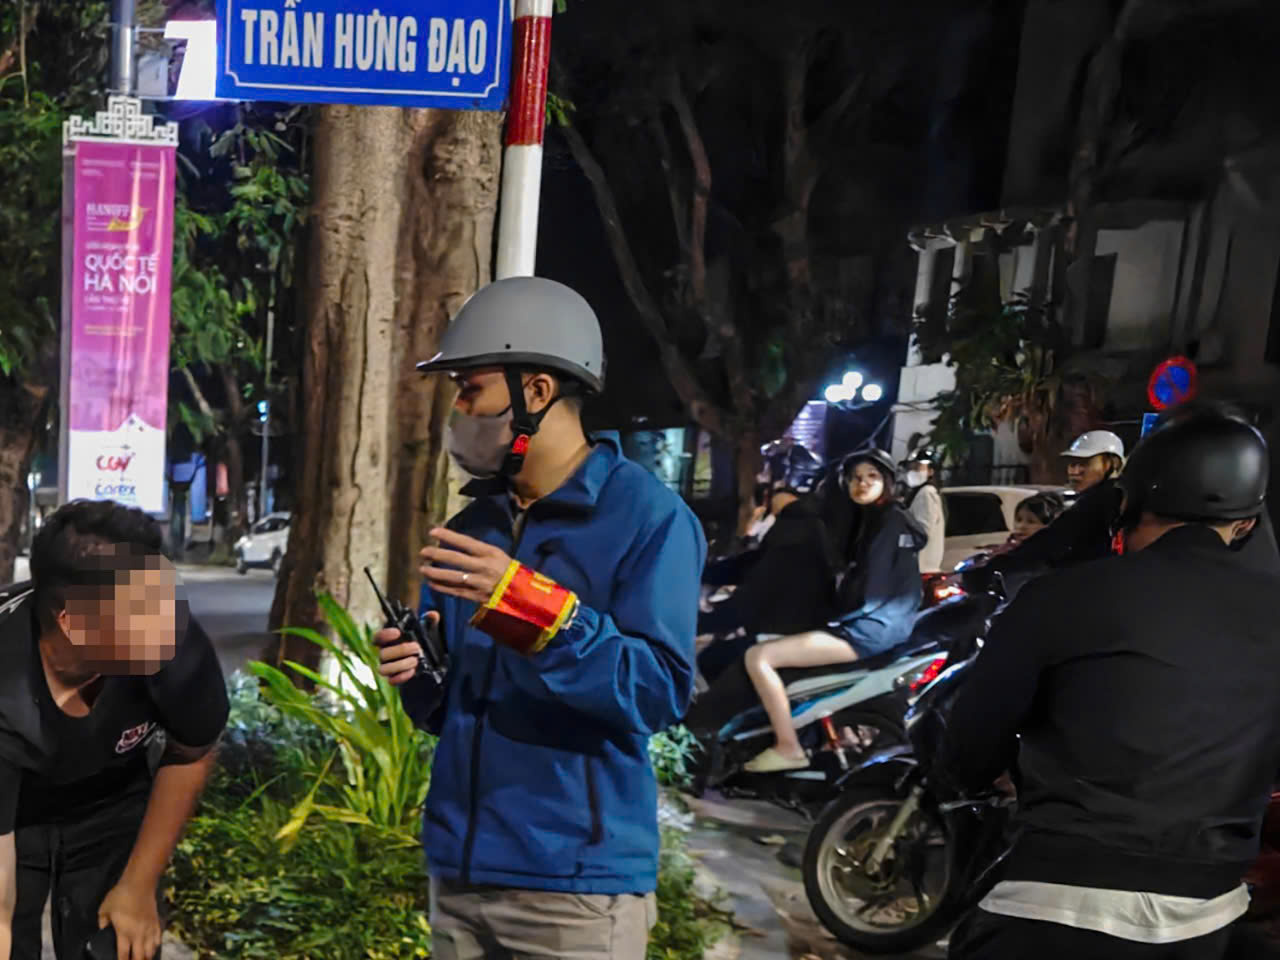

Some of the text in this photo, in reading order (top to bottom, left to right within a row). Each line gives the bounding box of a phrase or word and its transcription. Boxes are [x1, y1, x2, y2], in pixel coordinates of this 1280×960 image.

[241, 0, 488, 87] TRẦN HƯNG ĐẠO
